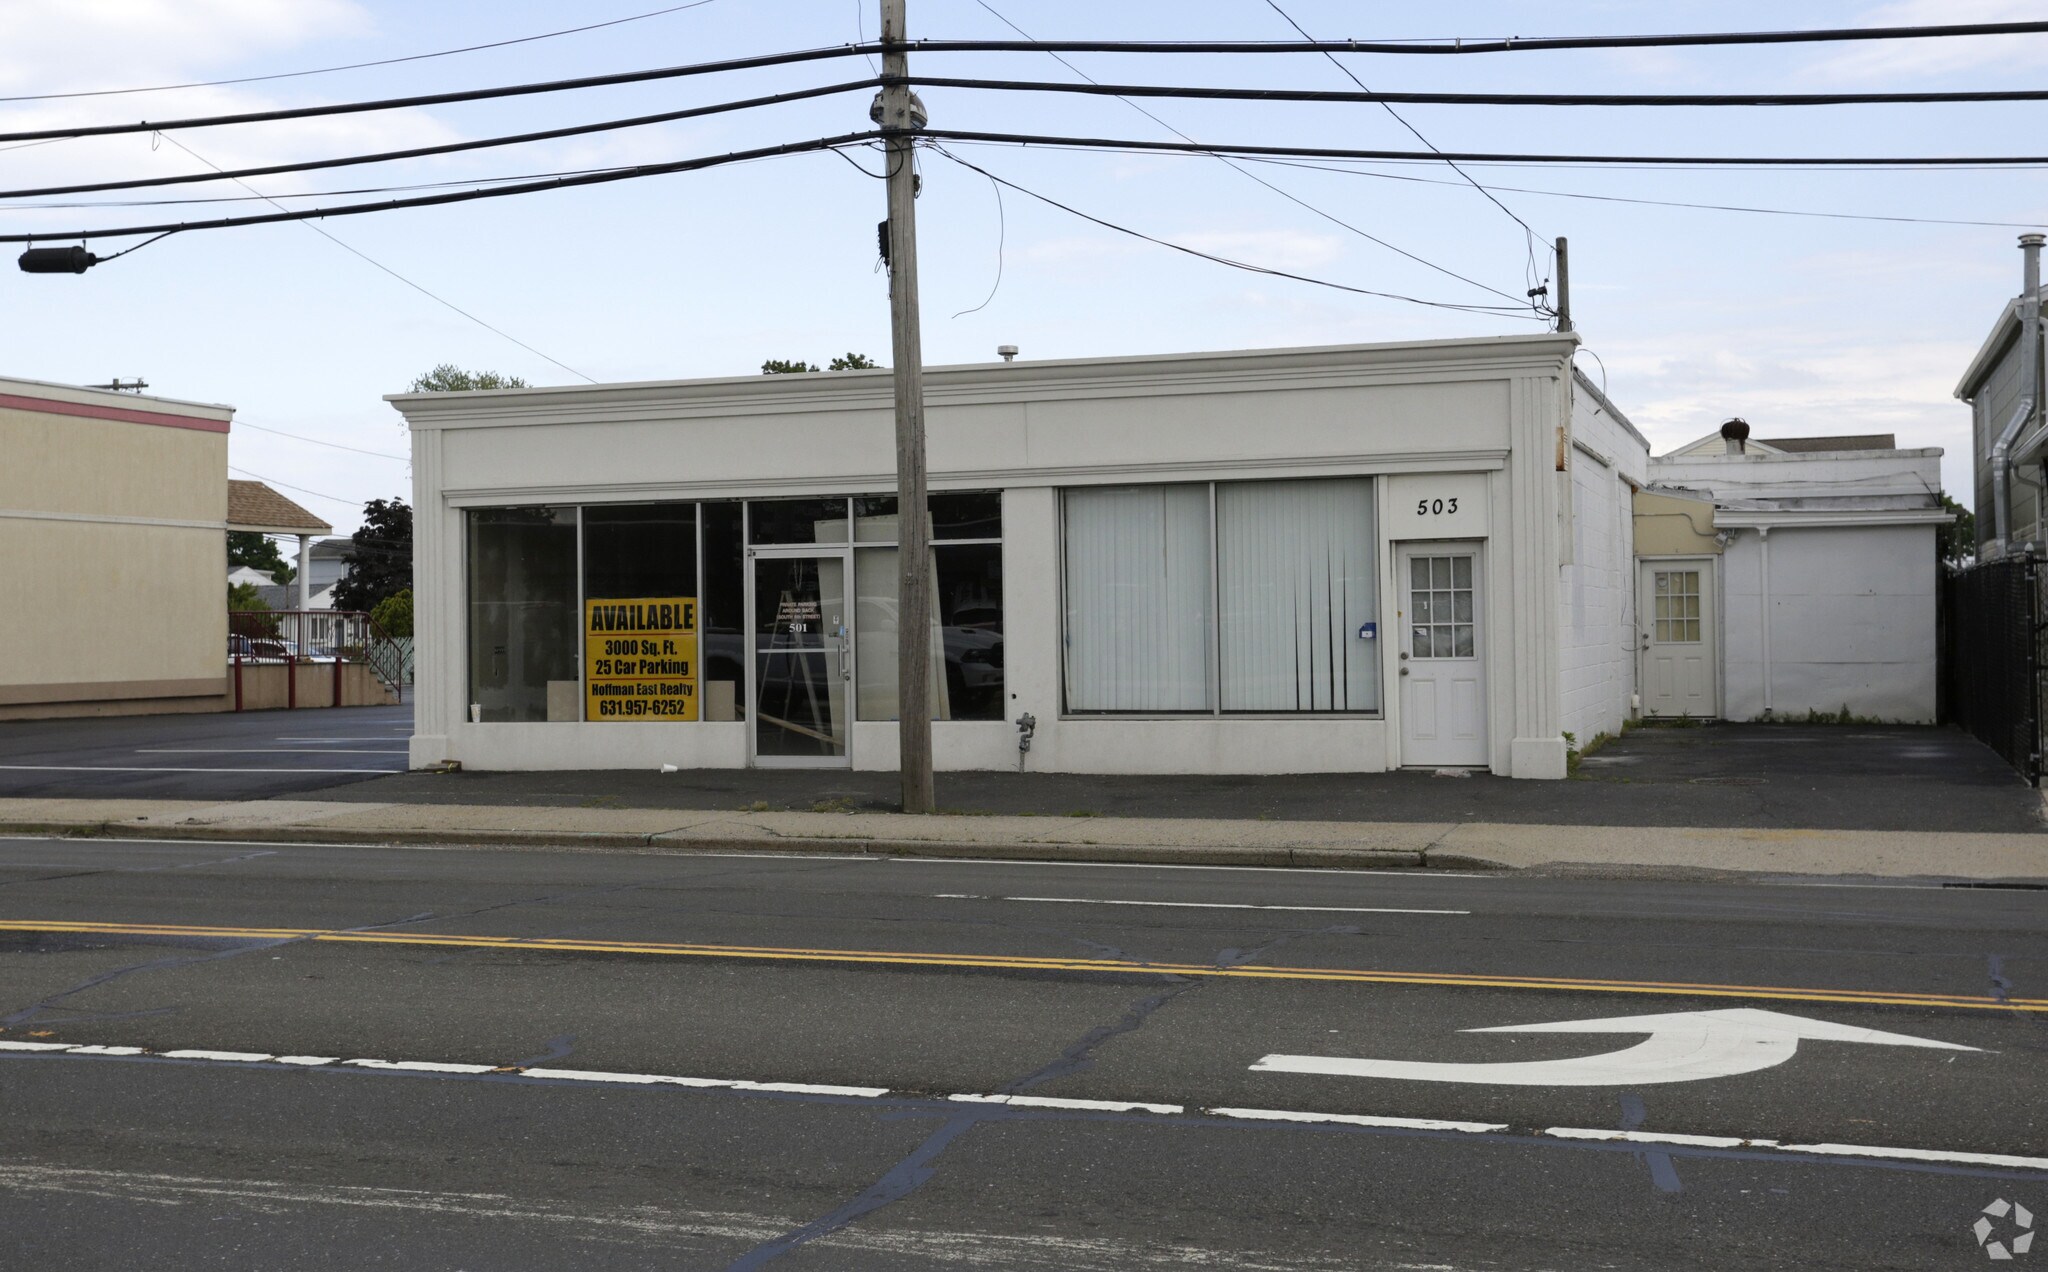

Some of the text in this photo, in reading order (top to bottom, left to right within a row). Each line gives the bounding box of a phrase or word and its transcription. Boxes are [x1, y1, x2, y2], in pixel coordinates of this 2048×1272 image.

[1417, 498, 1458, 515] 503
[591, 603, 693, 631] AVAILABLE
[789, 623, 807, 632] 501
[605, 640, 677, 656] 3000 Sq. Ft.
[596, 659, 689, 676] 25 Car Parking
[592, 683, 693, 696] Hoffman East Realty
[600, 700, 684, 715] 631.957-6252
